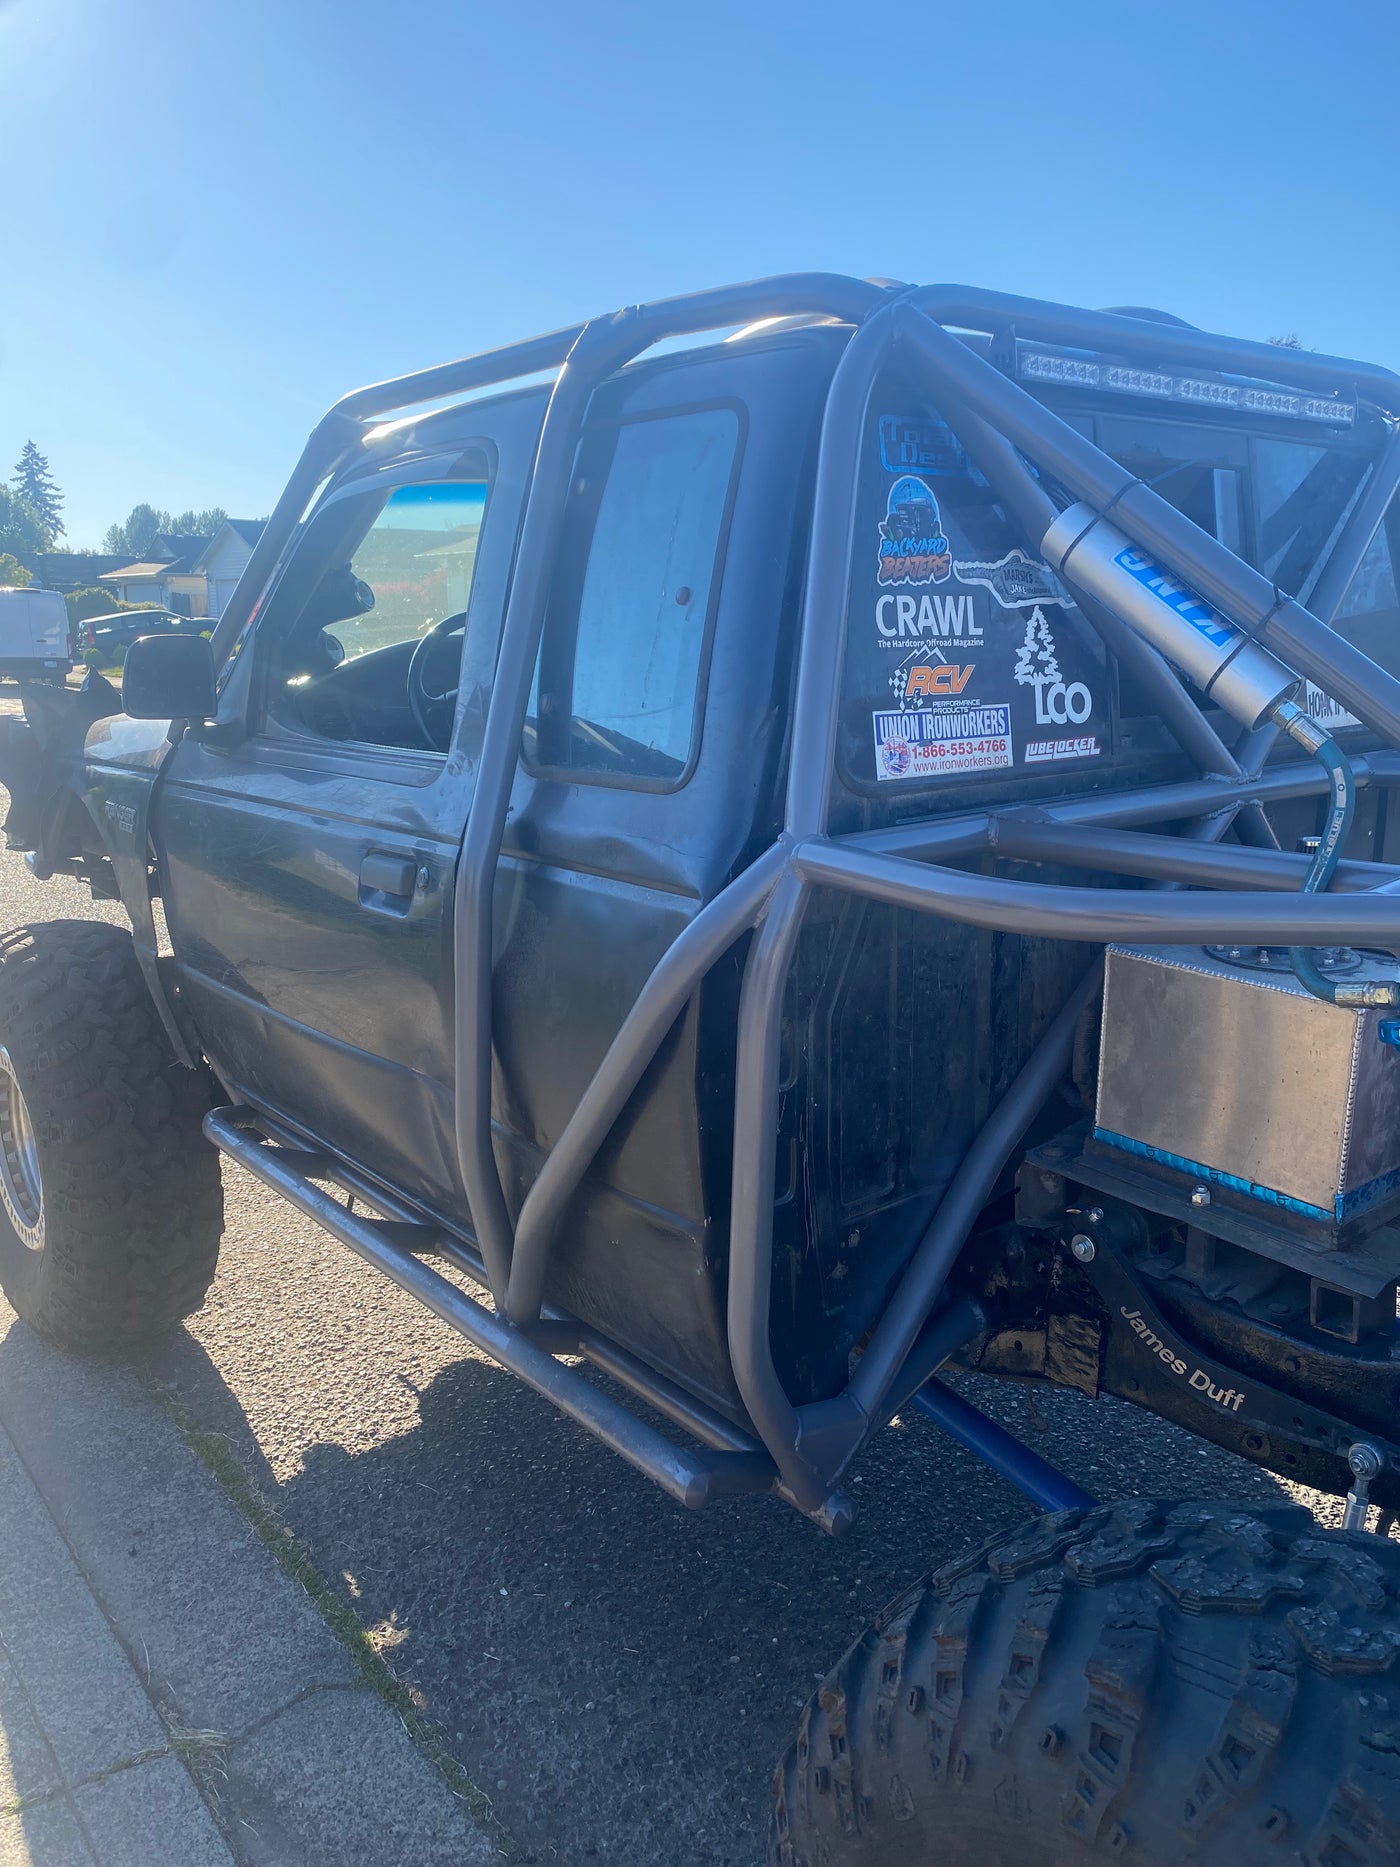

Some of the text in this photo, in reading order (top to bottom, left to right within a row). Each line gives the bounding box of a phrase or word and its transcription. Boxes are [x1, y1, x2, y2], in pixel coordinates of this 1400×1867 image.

[881, 537, 947, 557] BACKYARD
[881, 555, 950, 578] BEATERS
[1120, 551, 1232, 636] KING
[875, 594, 984, 638] CRAWL
[878, 638, 985, 649] The Hardcore Offroad Magazine
[905, 664, 976, 697] RCV
[932, 699, 981, 708] PERFORMANCE
[932, 706, 970, 715] PRODUCTS
[1034, 681, 1093, 725] LCO
[880, 709, 1006, 742] UNION IRONWORKERS
[912, 739, 1007, 759] 1-866-553-4766
[1024, 737, 1101, 763] LUBELOCKER
[914, 755, 1009, 773] www.ironworkers.org
[1120, 1306, 1246, 1412] James Duff
